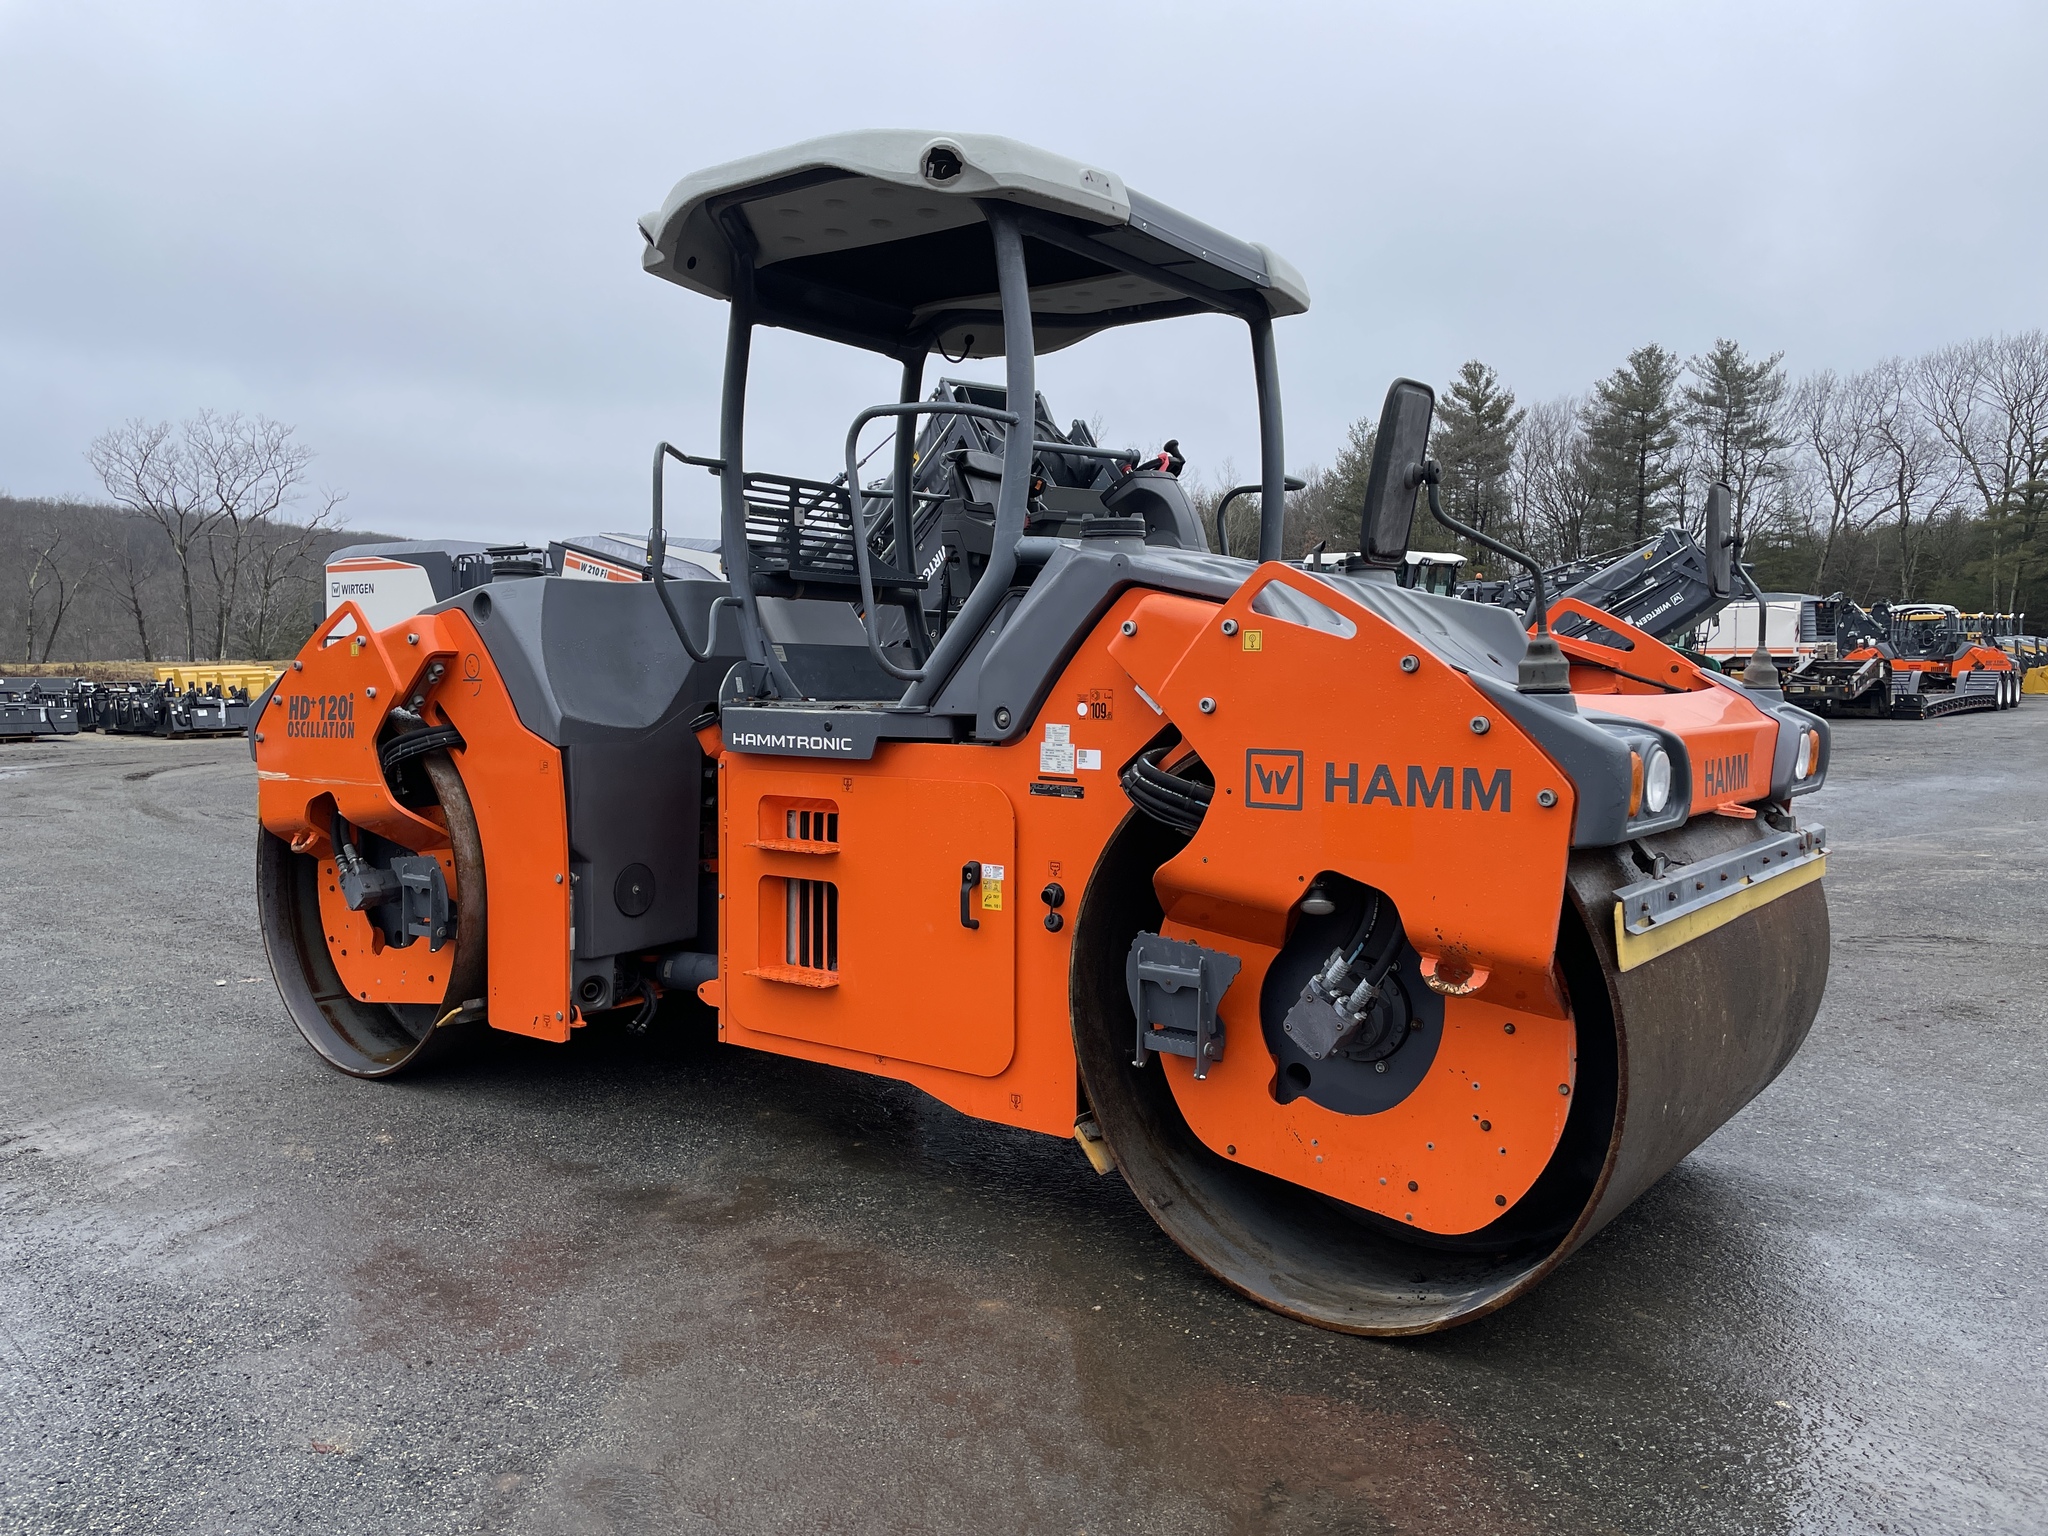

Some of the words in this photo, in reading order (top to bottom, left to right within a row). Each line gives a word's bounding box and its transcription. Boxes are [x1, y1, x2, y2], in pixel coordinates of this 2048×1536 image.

[580, 562, 587, 572] W
[588, 565, 599, 576] 210
[600, 569, 608, 579] Fi
[917, 545, 946, 581] IRTG
[341, 583, 375, 595] WIRTGEN
[1635, 601, 1672, 628] WIRTGEN
[1090, 702, 1107, 719] 109
[287, 721, 355, 739] OSCILLATION
[732, 732, 853, 751] HAMMTRONIC
[1704, 753, 1749, 798] HAMM
[1325, 762, 1512, 812] HAMM
